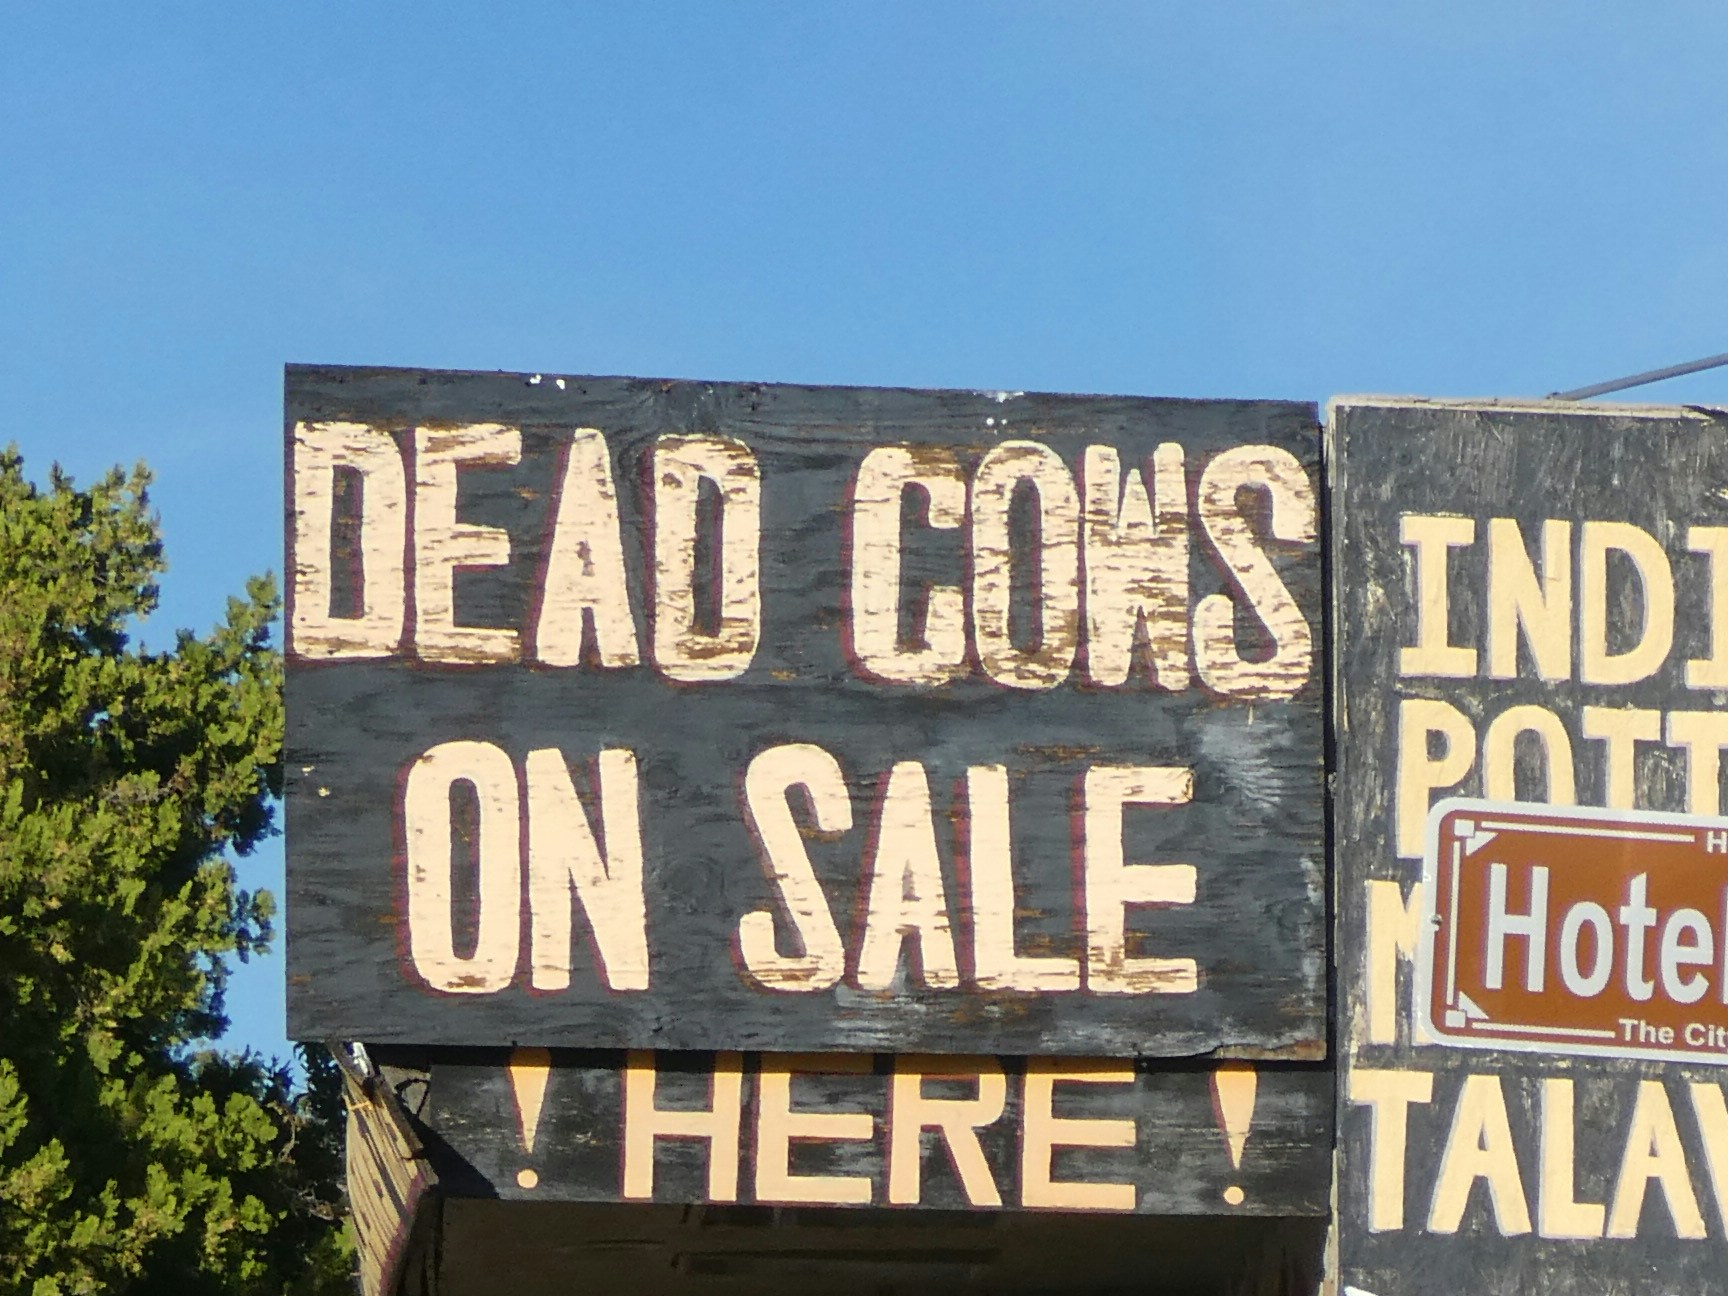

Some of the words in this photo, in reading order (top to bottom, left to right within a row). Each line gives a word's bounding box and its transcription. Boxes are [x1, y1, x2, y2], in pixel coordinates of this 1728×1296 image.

[290, 420, 761, 684] DEAD
[849, 437, 1315, 700] COWS
[405, 739, 650, 994] ON
[737, 741, 1200, 995] SALE
[621, 1050, 1137, 1209] HERE
[1618, 1017, 1674, 1047] The
